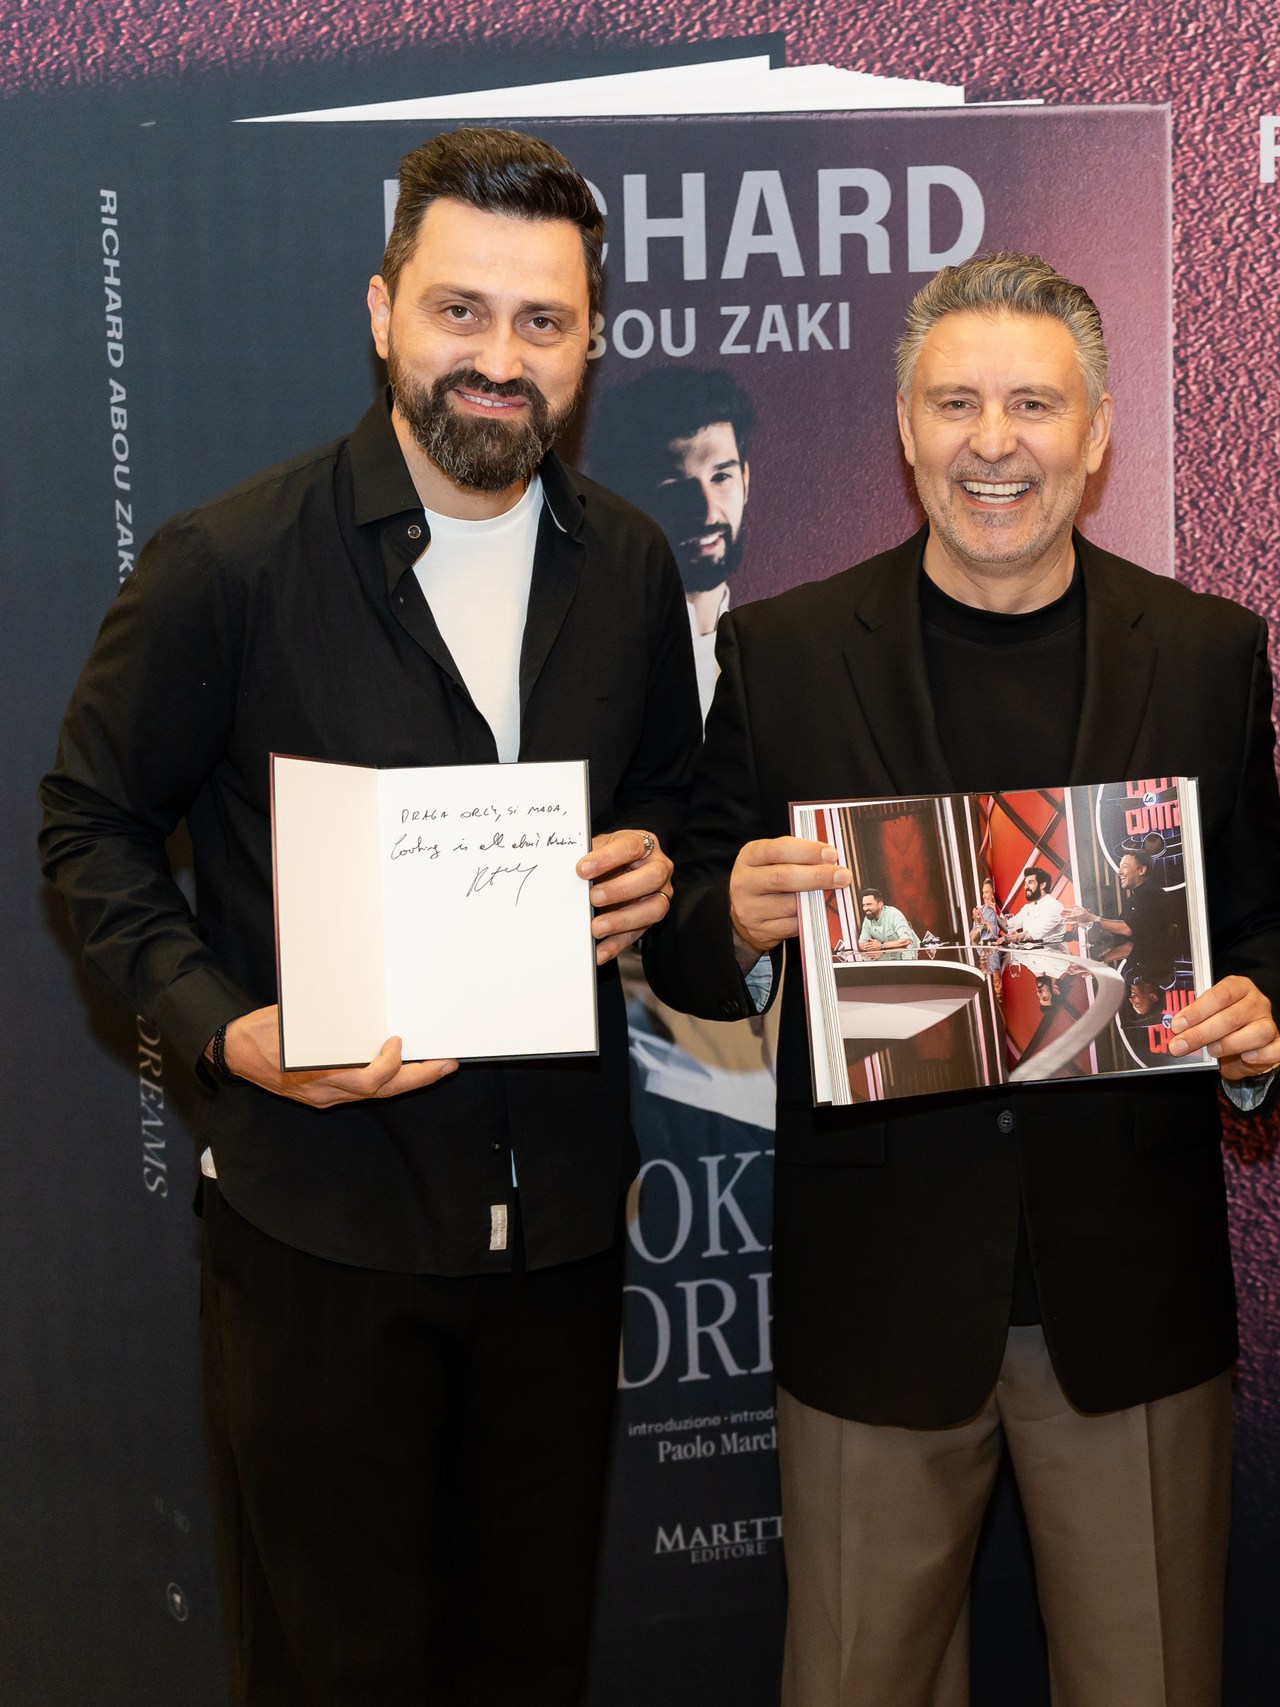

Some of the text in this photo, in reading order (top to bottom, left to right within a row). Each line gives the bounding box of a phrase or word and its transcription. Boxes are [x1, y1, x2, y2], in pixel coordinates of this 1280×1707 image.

[586, 302, 851, 360] BOU ZAKI
[100, 189, 135, 584] RICHARD ABOU ZAK
[401, 808, 449, 823] DRAGA
[628, 1406, 775, 1437] introduzione introd
[658, 1425, 778, 1463] Paolo Marc
[654, 1515, 784, 1555] MARETT
[690, 1540, 767, 1564] EDITORE
